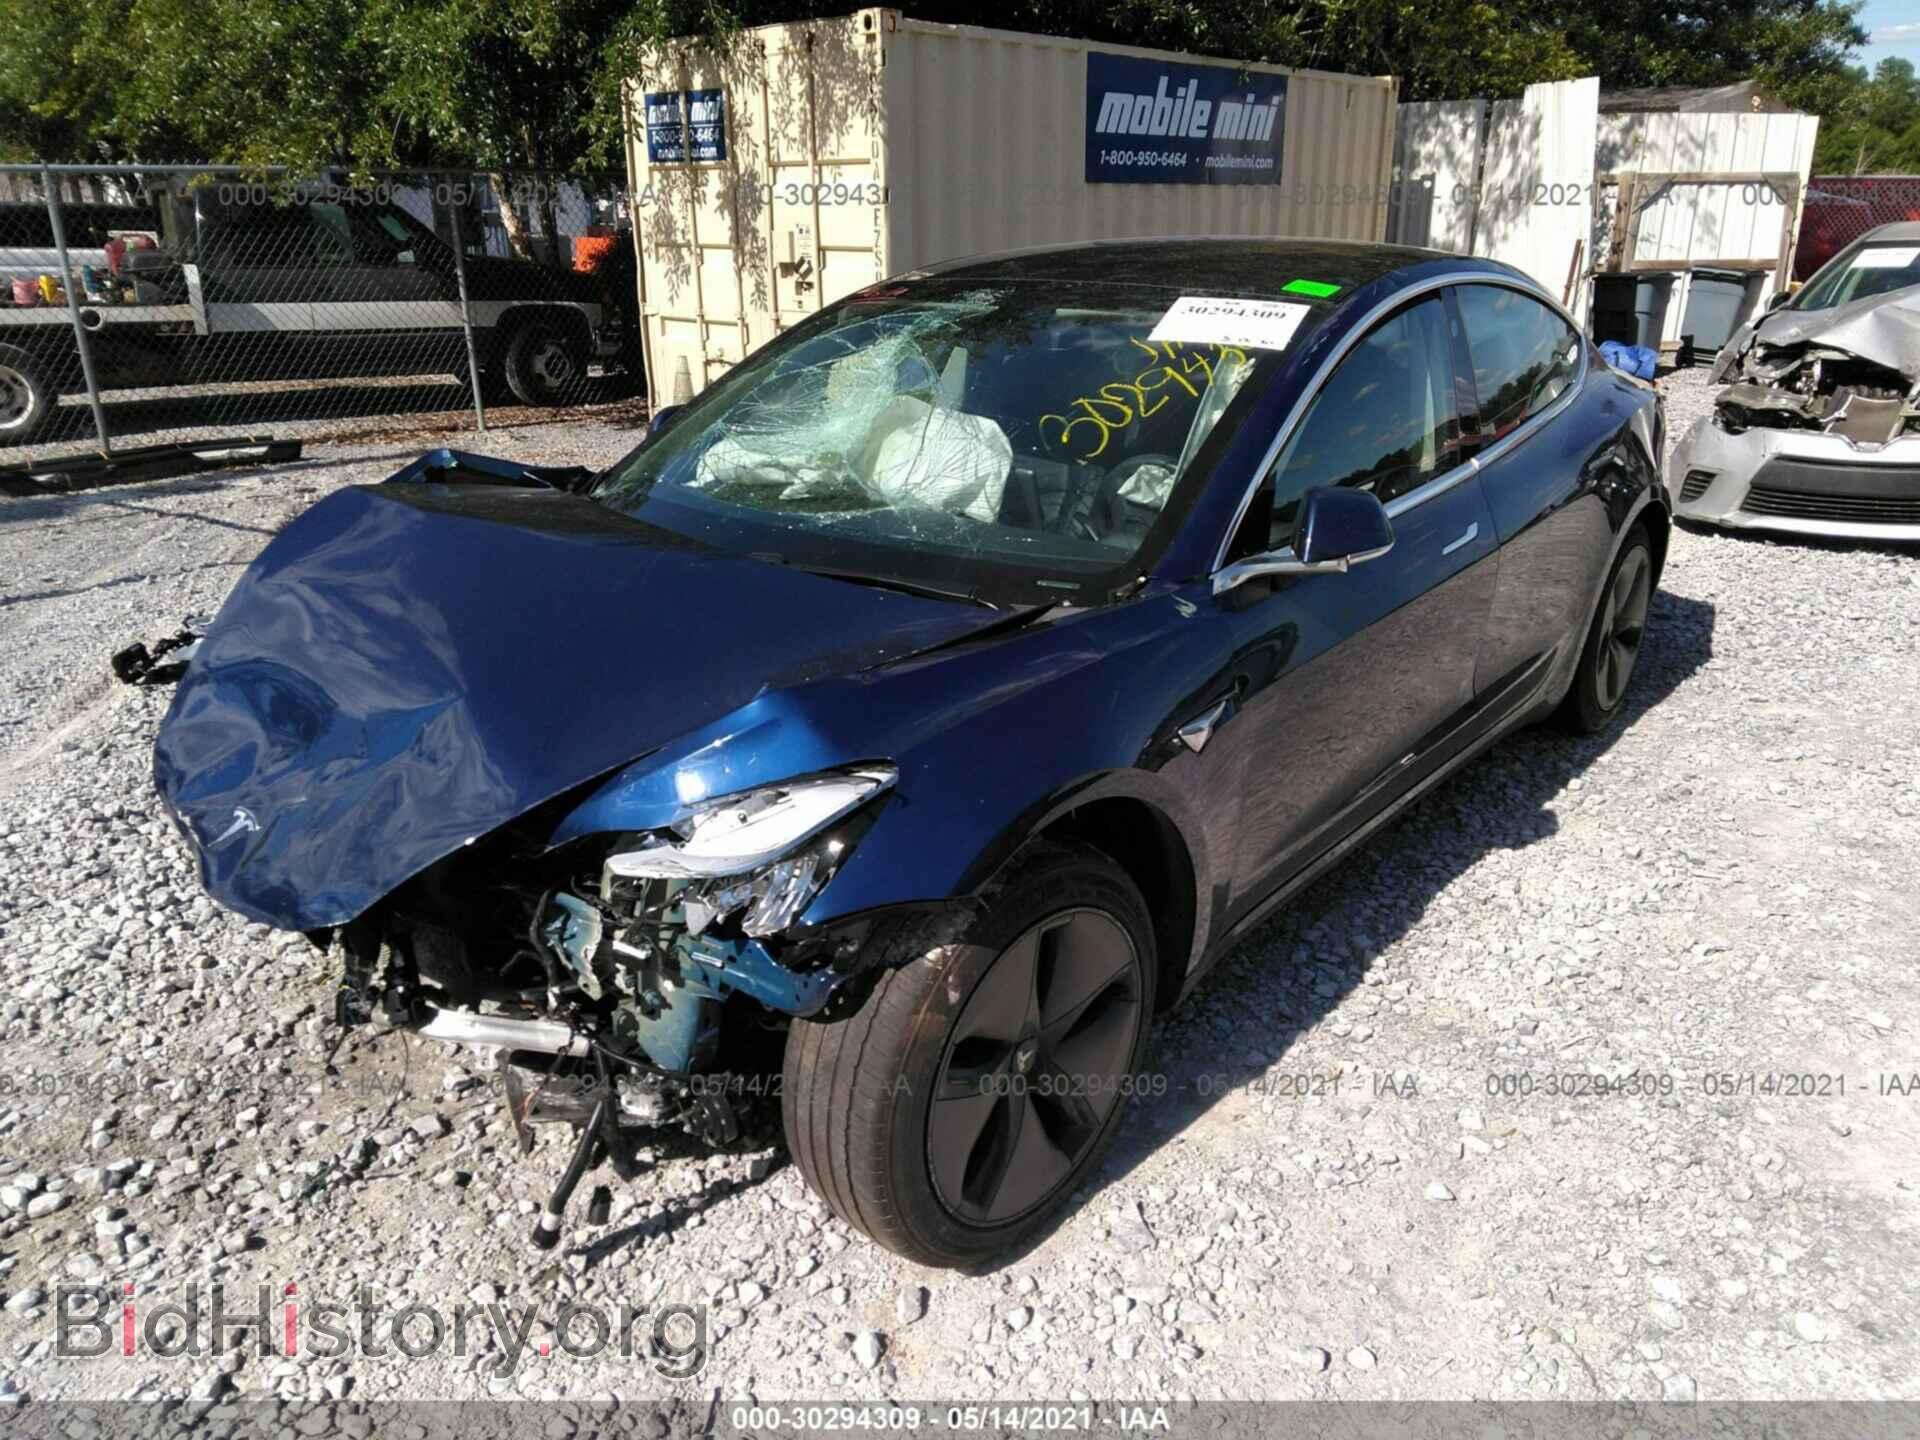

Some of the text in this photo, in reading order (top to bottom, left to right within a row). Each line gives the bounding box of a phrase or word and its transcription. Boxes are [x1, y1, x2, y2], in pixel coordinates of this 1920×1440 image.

[1096, 75, 1280, 141] mobile mini
[1100, 150, 1273, 169] 1-800-950-6464 mobilemini.com
